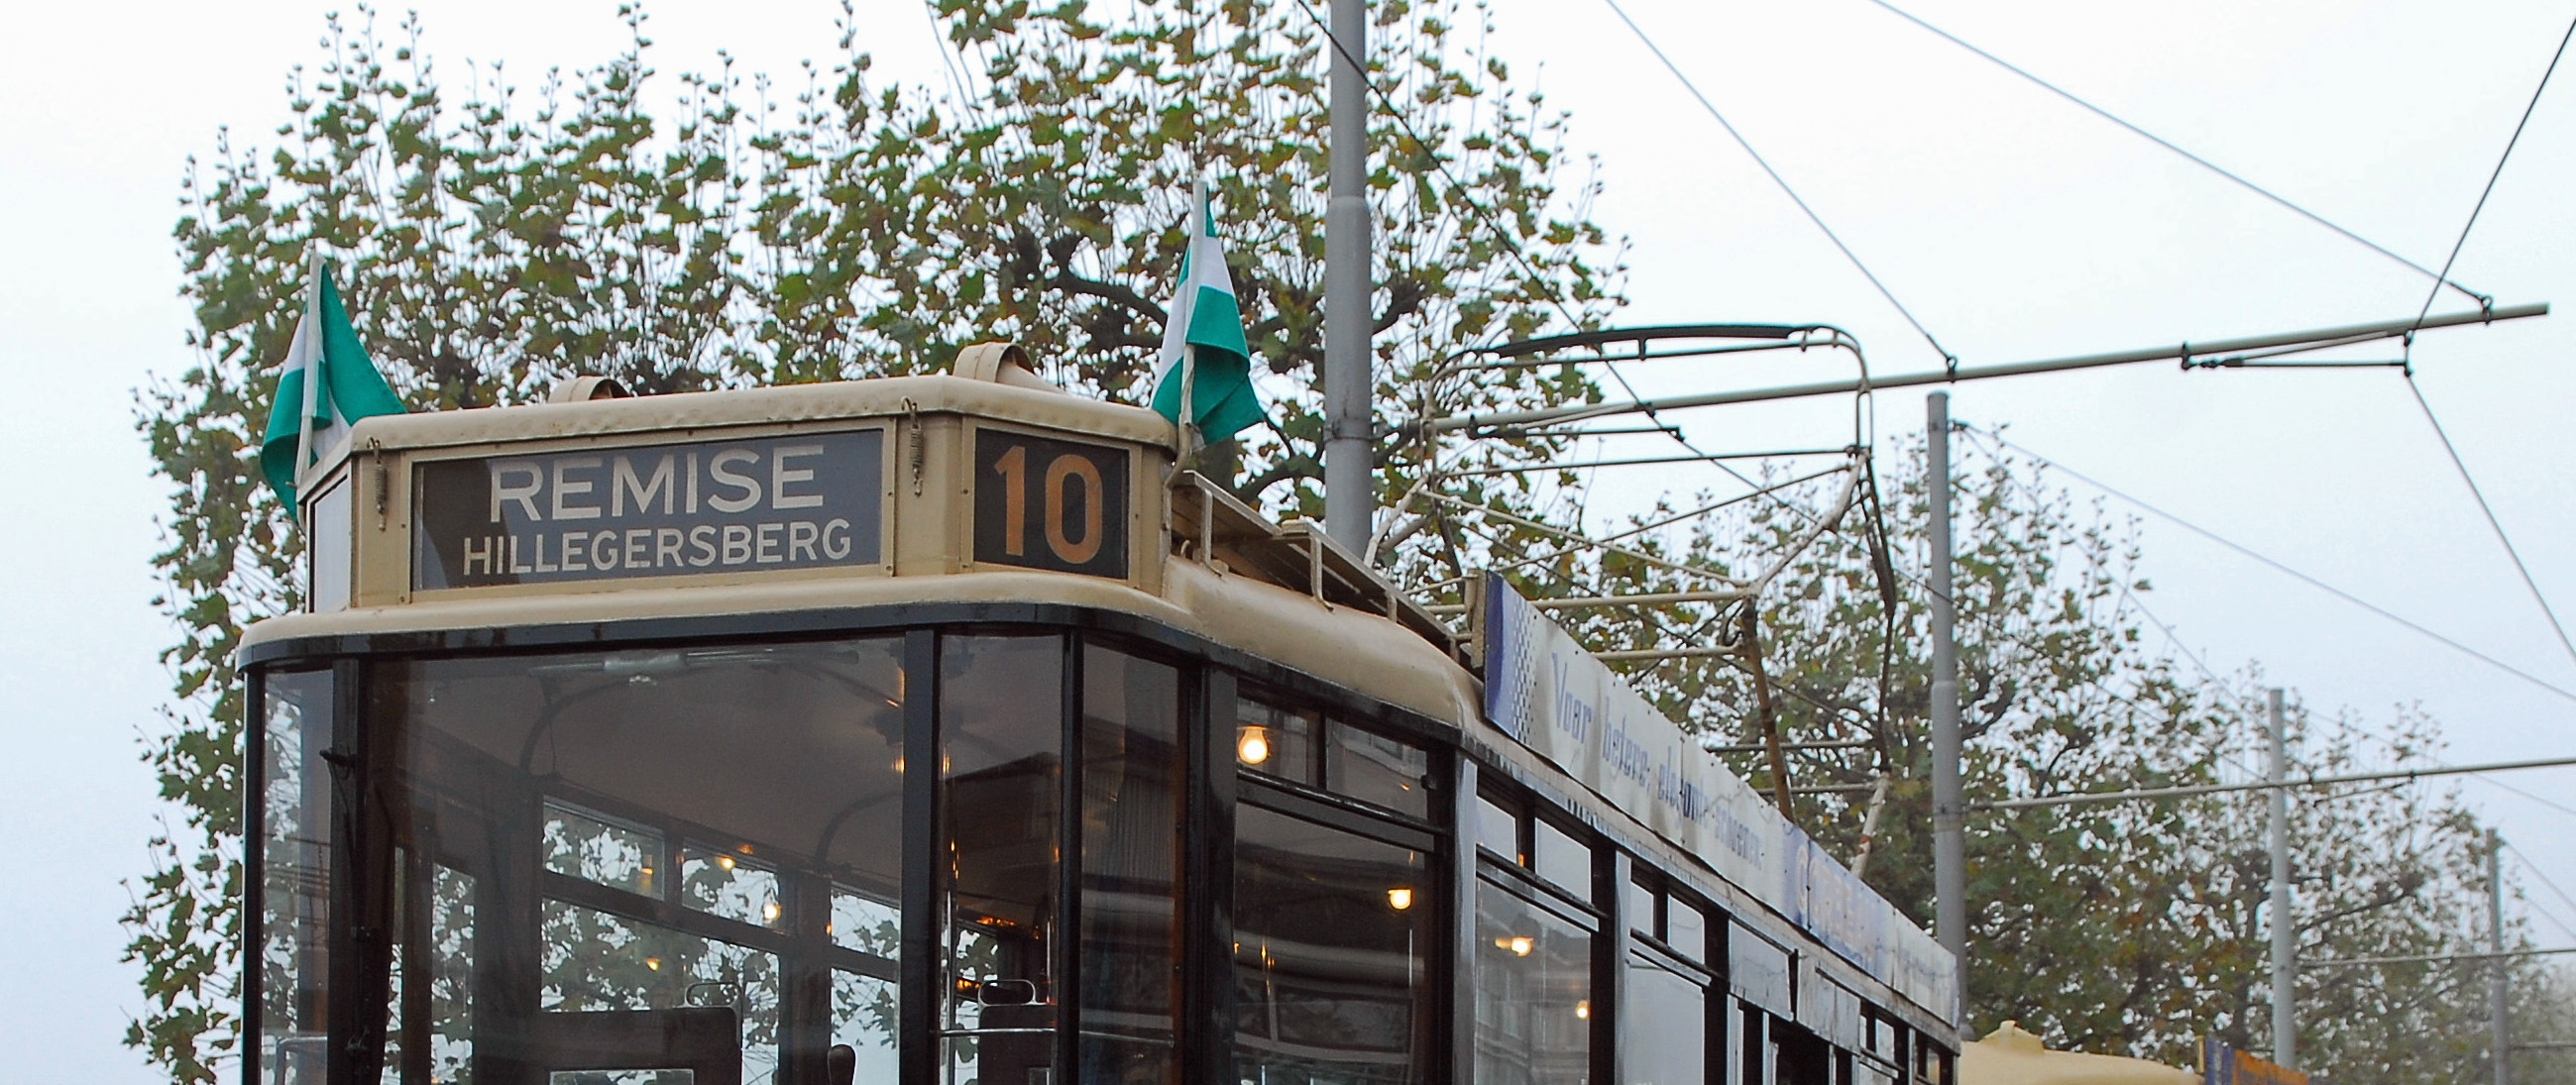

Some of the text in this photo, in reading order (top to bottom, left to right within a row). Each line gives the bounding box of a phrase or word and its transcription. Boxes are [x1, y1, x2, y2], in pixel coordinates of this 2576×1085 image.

[490, 444, 825, 523] REMISE
[994, 446, 1103, 565] 10
[463, 517, 851, 577] HILLEGERSBERG
